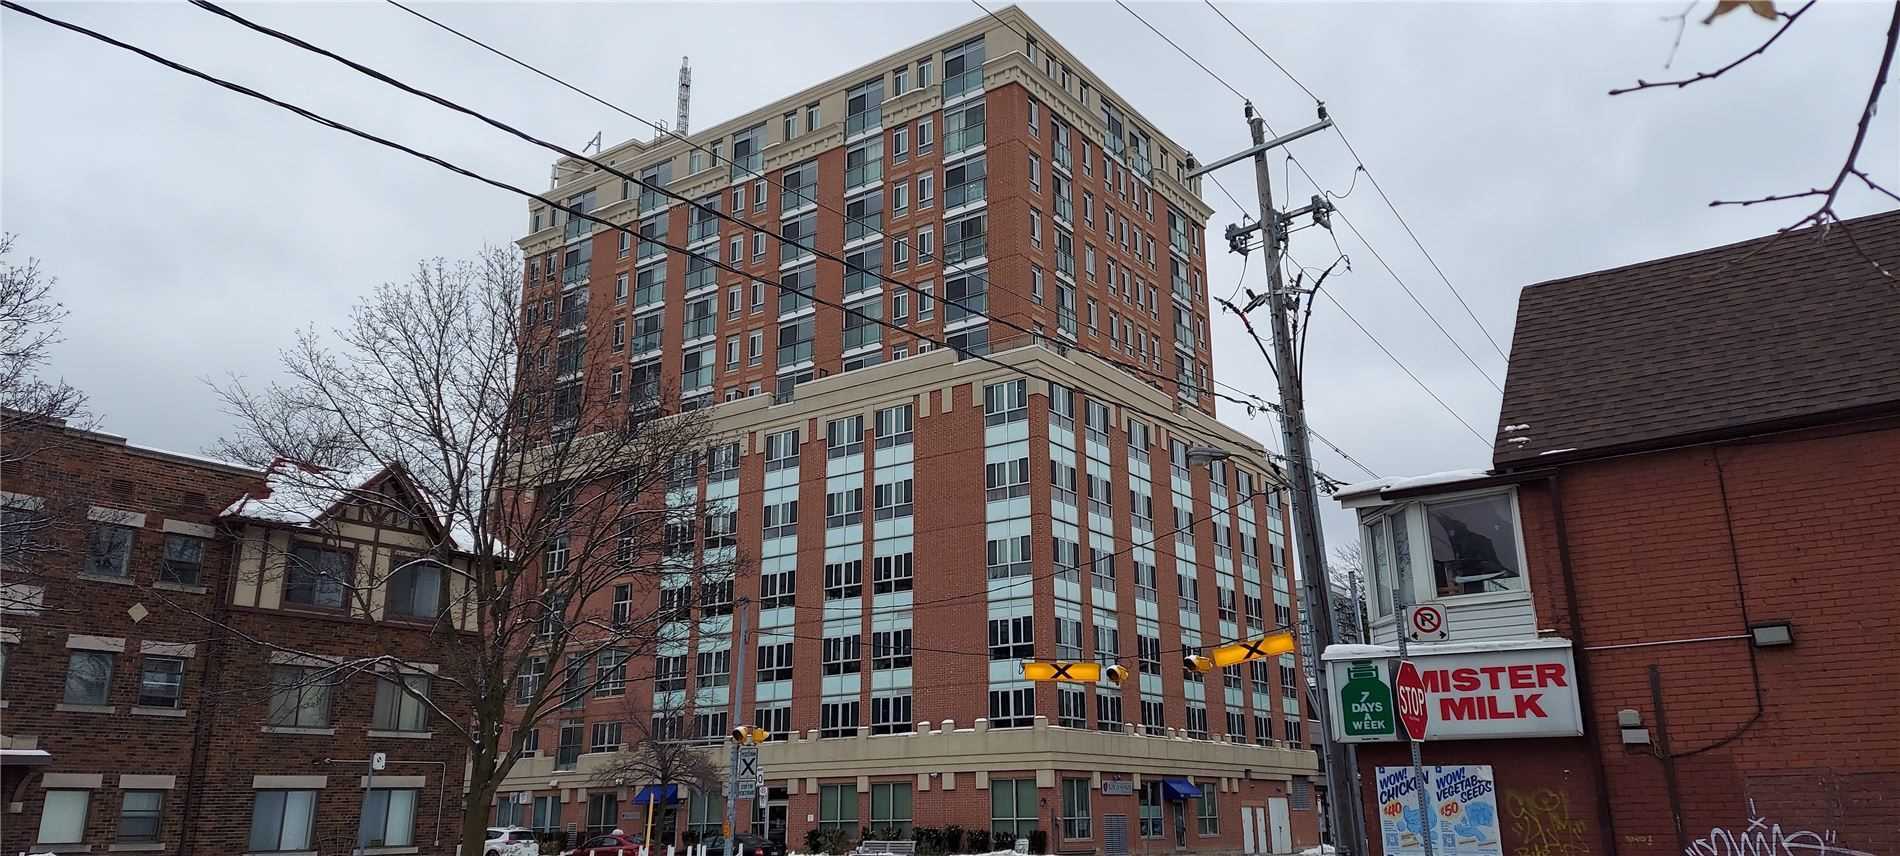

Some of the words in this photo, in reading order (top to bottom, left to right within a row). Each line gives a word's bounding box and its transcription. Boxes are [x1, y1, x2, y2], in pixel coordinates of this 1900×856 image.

[1351, 702, 1384, 713] DAYS
[1360, 691, 1370, 702] 7
[1400, 685, 1425, 717] STOP
[1440, 693, 1548, 722] MILK
[1352, 720, 1386, 730] WEEK
[1379, 767, 1408, 790] WOW!
[1379, 770, 1429, 805] CHICKN
[1436, 767, 1466, 789] WOW!
[1460, 780, 1493, 803] SEEDS
